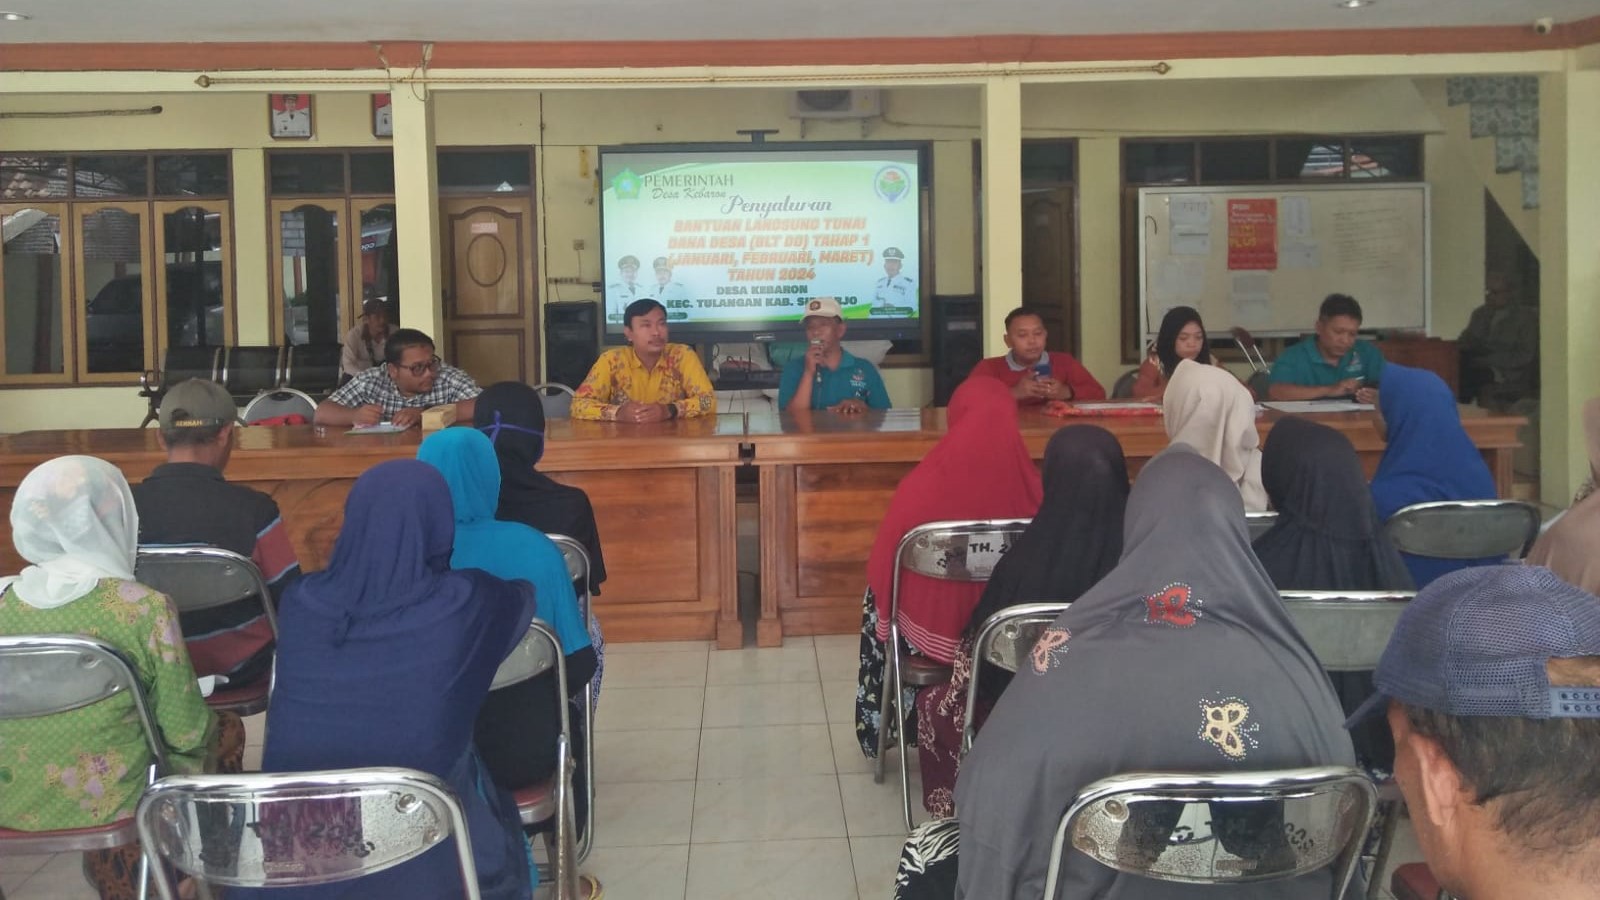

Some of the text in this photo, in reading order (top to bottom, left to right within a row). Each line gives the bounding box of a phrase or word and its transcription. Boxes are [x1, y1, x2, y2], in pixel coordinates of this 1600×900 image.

[644, 174, 734, 187] PEMERINTAH
[652, 186, 726, 199] Desa Kebaron
[720, 195, 832, 218] Penyaluran
[674, 217, 867, 232] BANTUAN LANGSUNG TUNAI
[668, 236, 705, 249] DANA
[709, 235, 747, 248] DESA
[813, 234, 859, 247] TAHAP
[861, 233, 870, 247] 1
[742, 251, 816, 266] FEBRUARI,
[819, 250, 874, 266] MARET)
[727, 267, 816, 281] TAHUN 2024
[716, 285, 808, 295] DESA KEBARON
[666, 299, 694, 309] KEC.
[697, 298, 762, 308] TULANGAN
[765, 297, 794, 307] KAB.
[968, 541, 995, 554] TH.
